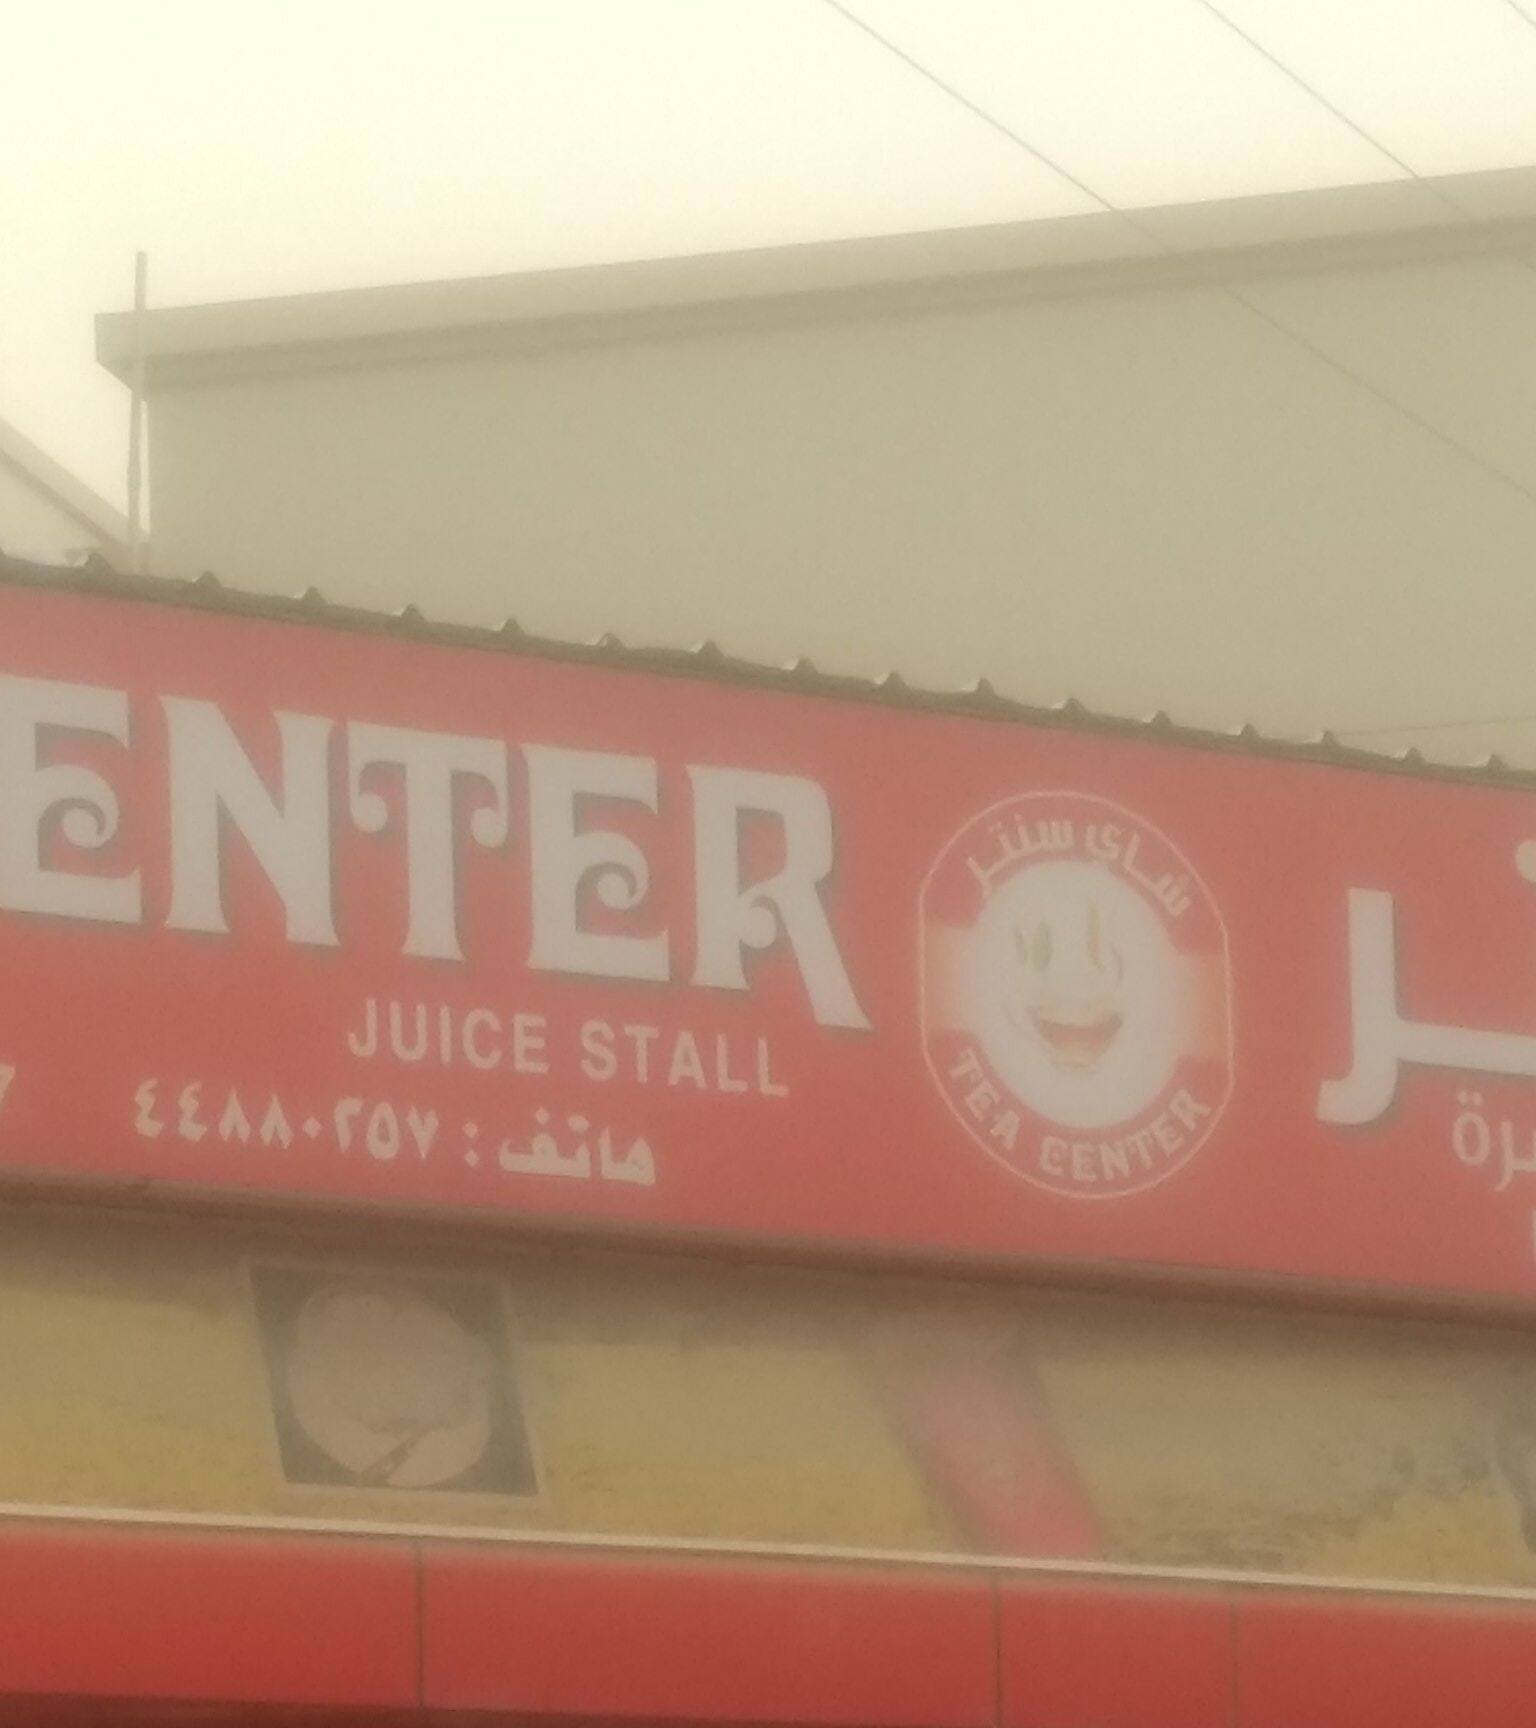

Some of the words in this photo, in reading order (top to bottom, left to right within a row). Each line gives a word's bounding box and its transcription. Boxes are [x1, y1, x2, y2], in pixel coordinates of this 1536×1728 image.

[347, 996, 550, 1077] JUICE
[578, 1017, 791, 1099] STALL
[497, 1106, 658, 1189] هاتف
[948, 1045, 1022, 1152] TEA
[1037, 1087, 1212, 1182] CENTER
